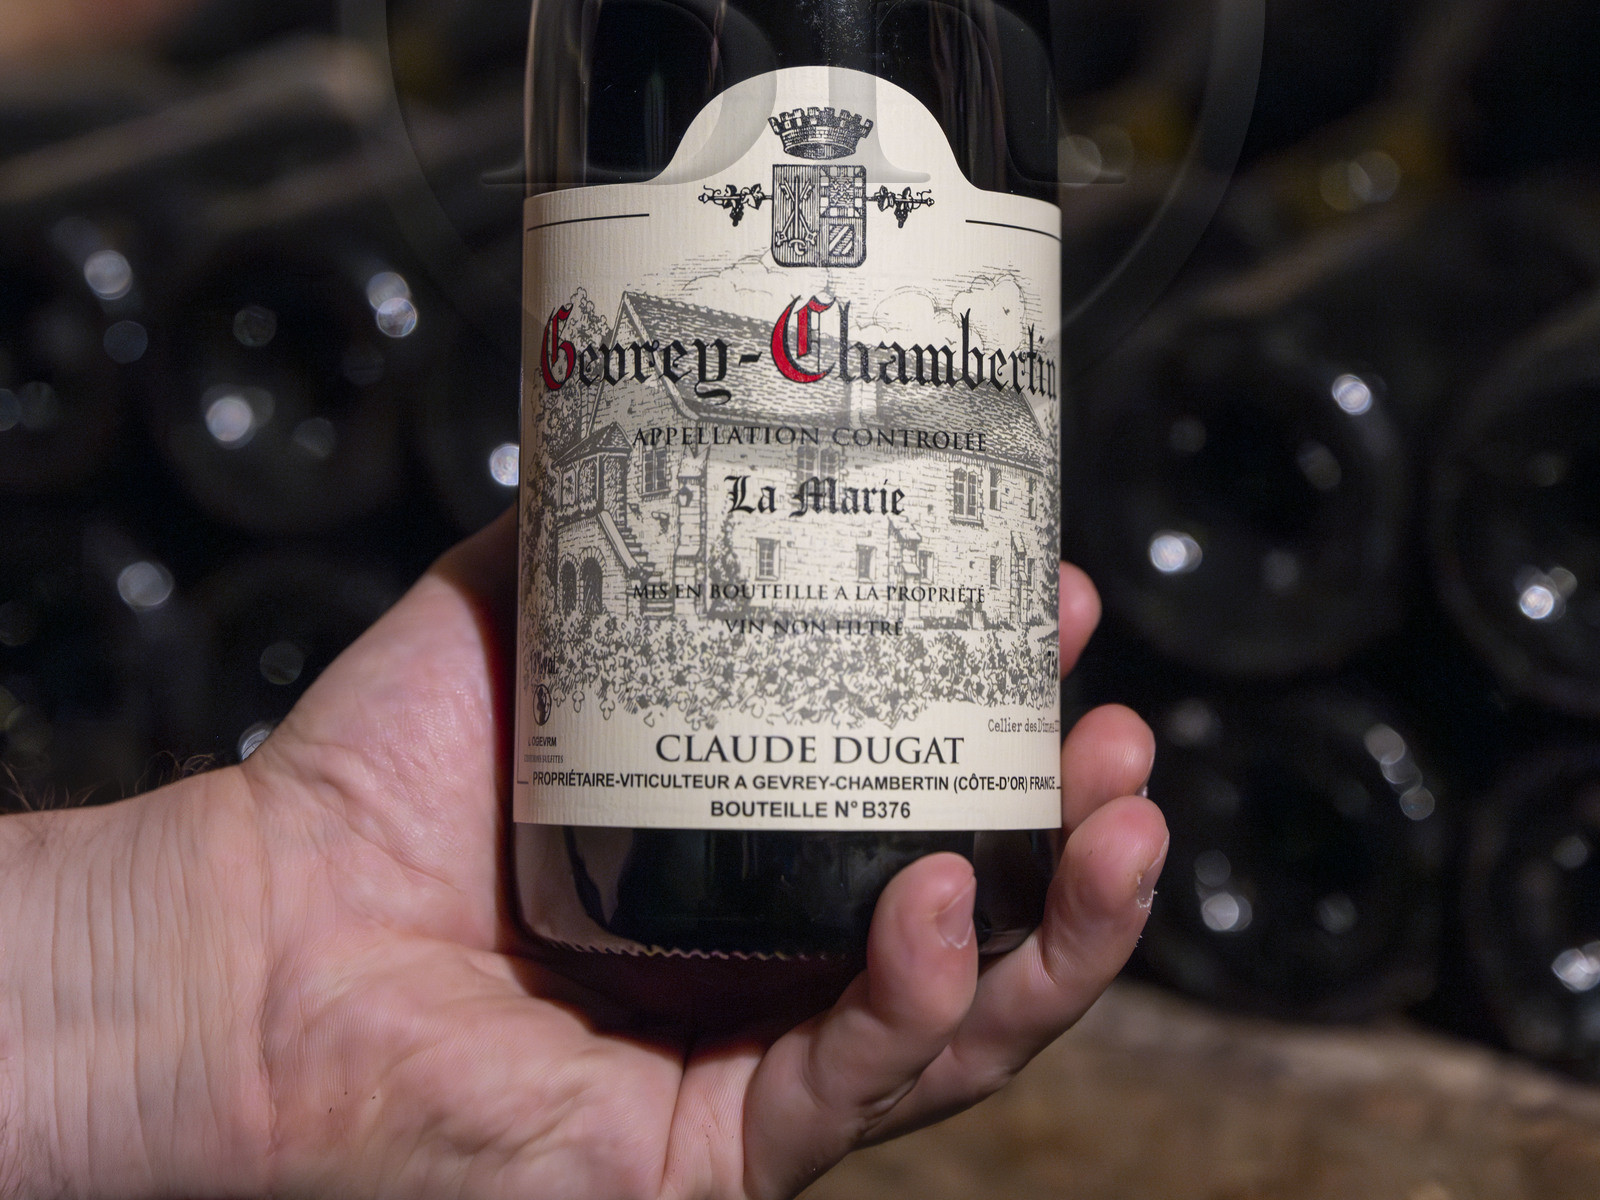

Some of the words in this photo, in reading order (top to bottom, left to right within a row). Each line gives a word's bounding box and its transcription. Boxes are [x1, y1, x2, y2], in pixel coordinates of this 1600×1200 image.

[541, 295, 1057, 405] Gevrey-Chambertin
[632, 426, 819, 446] APPELLATION
[832, 427, 987, 451] CONTROLÉE
[724, 475, 777, 514] La
[789, 475, 905, 517] Marie
[633, 584, 668, 599] MIS
[675, 584, 701, 599] EN
[711, 584, 828, 600] BOUTEILLE
[835, 586, 848, 600] A
[856, 585, 879, 600] LA
[887, 584, 985, 603] PROPRIÉTÉ
[725, 619, 764, 634] VIN
[774, 619, 826, 635] NON
[836, 617, 903, 636] FILTRÉ
[988, 717, 1023, 733] Cellier
[1024, 718, 1038, 733] des
[656, 734, 817, 764] CLAUDE
[833, 736, 965, 764] DUGAT
[532, 769, 730, 789] PROPRIÉTAIRE-VITICULTEUR
[734, 775, 747, 789] A
[753, 775, 949, 791] GEVREY-CHAMBERTIN
[953, 773, 1028, 794] (CÔTE-D'OR)
[1029, 776, 1056, 790] FRANCE
[711, 801, 828, 818] BOUTEILLE
[862, 801, 911, 819] B376
